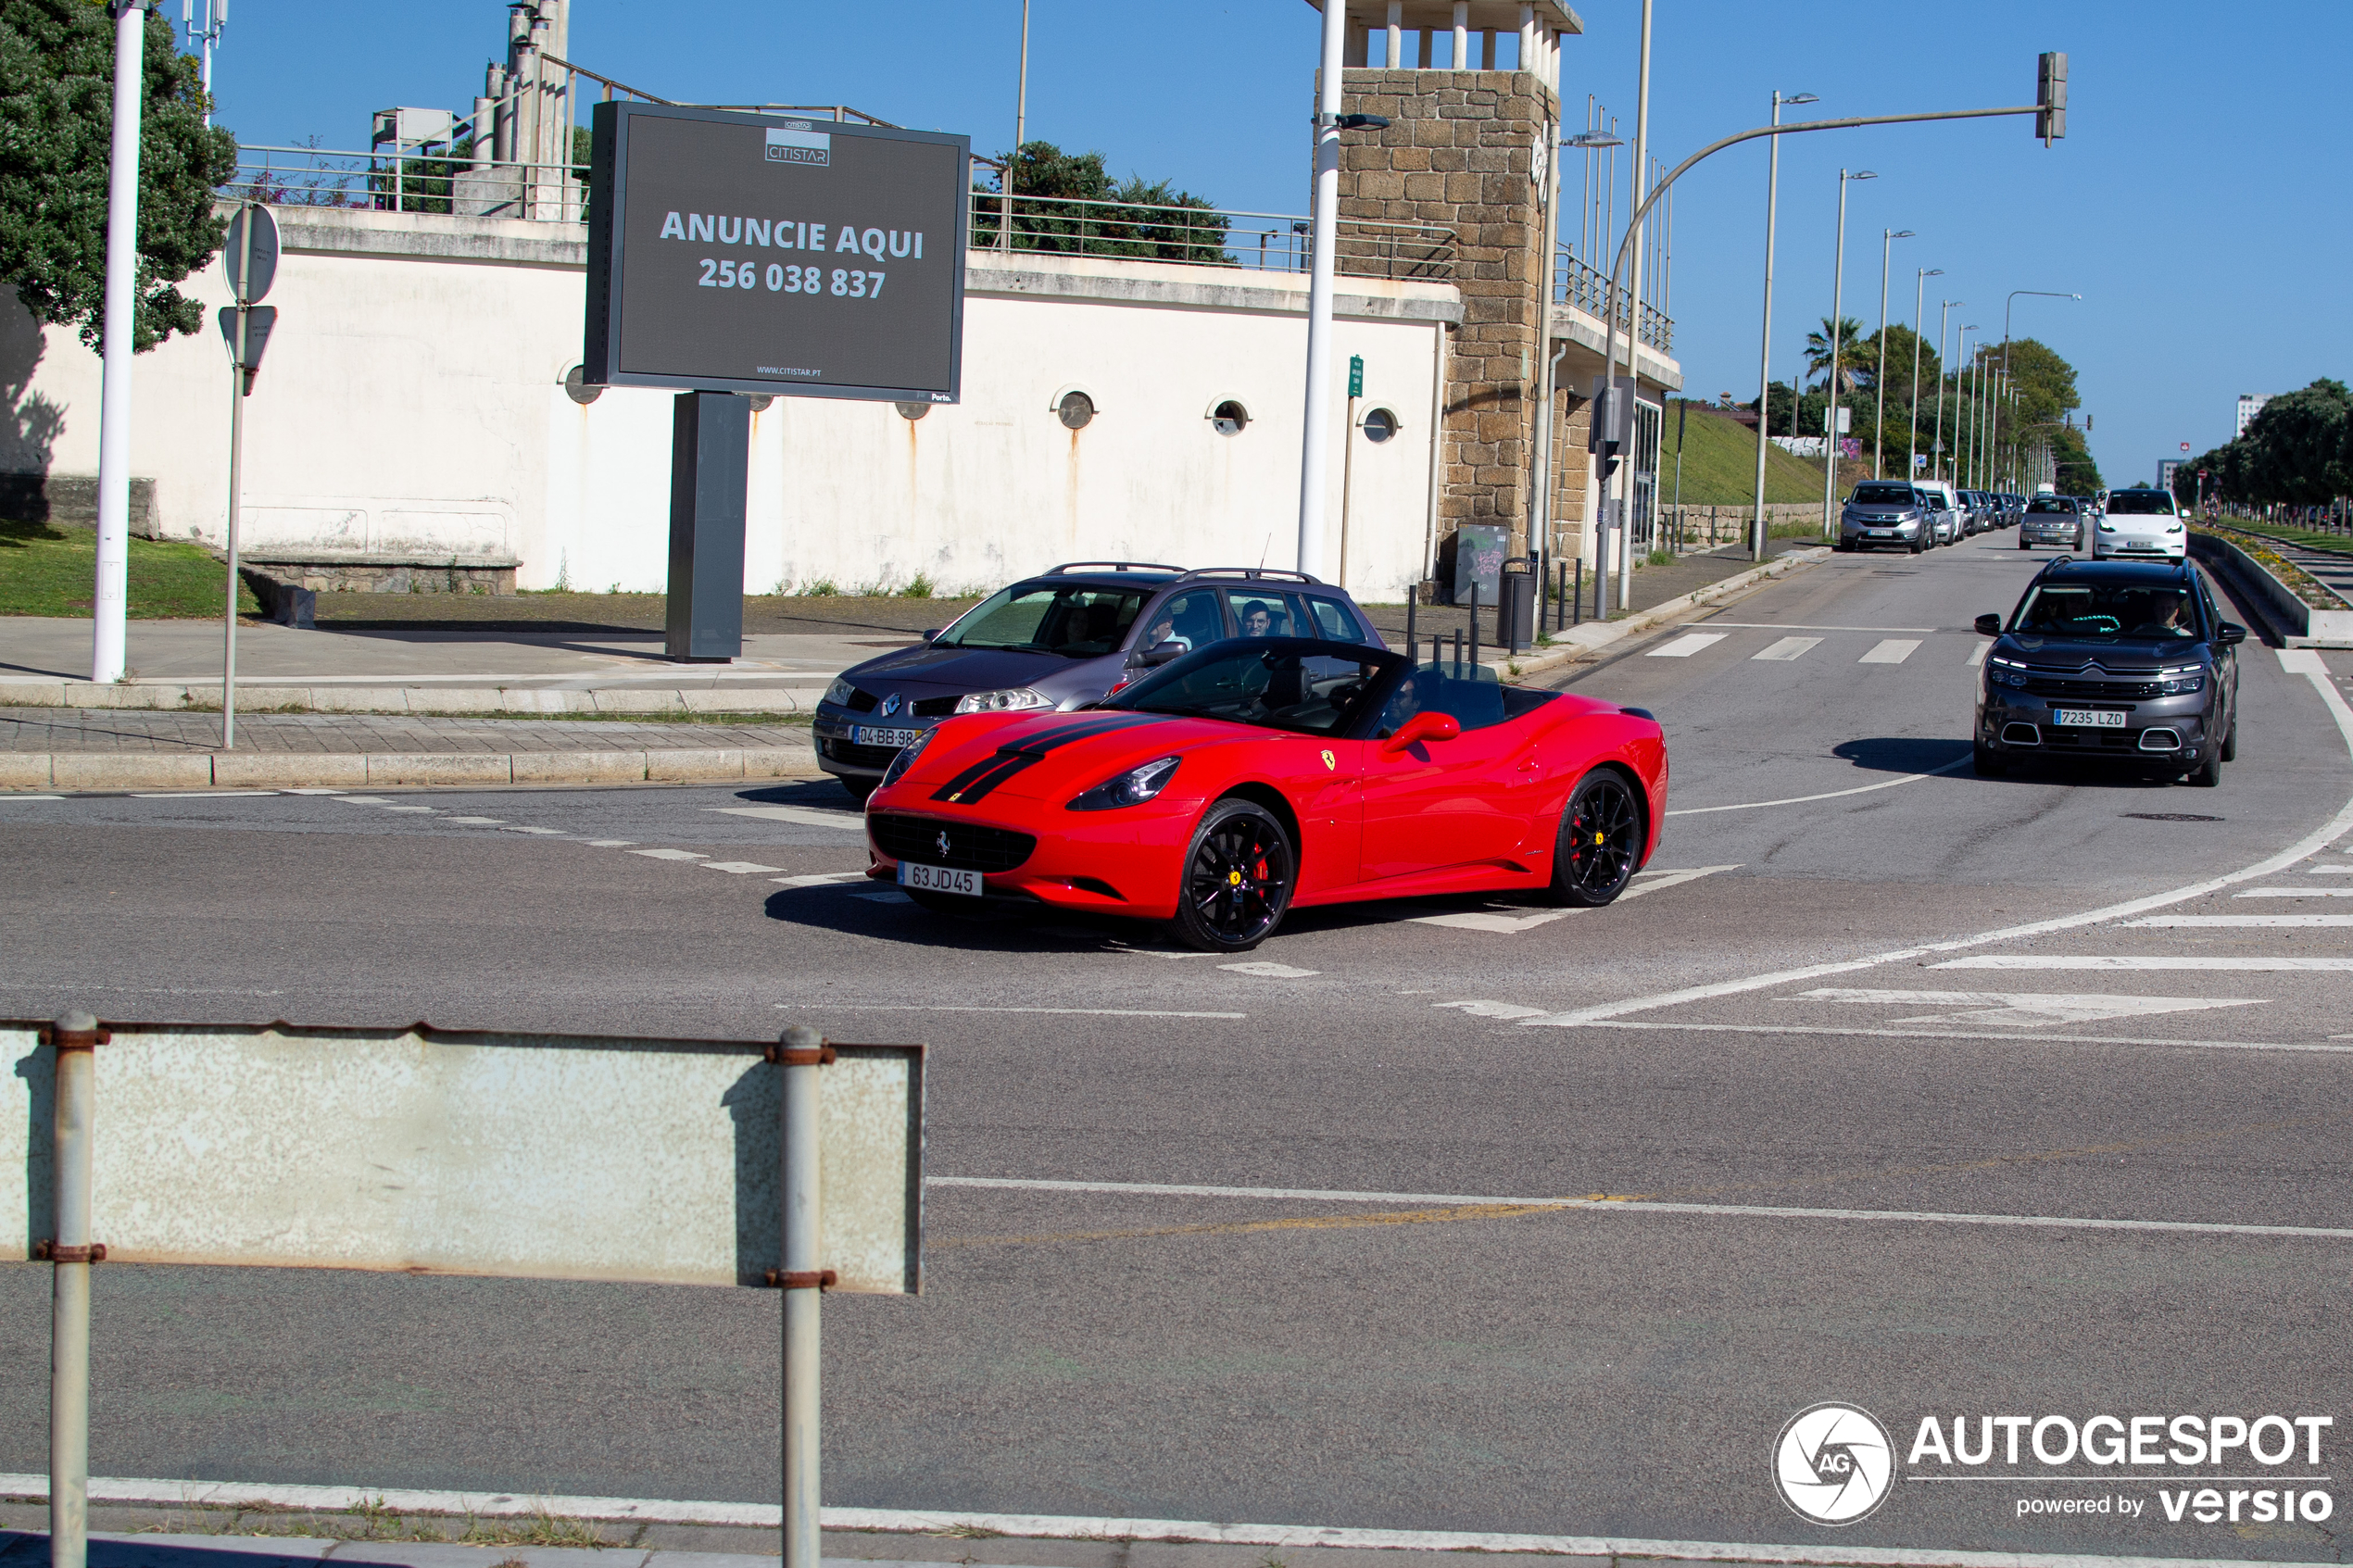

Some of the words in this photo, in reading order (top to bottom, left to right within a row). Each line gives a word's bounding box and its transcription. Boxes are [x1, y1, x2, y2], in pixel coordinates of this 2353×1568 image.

[769, 146, 826, 163] CITISTAR
[660, 211, 825, 252] ANUNCIE
[835, 226, 924, 262] AQUI
[698, 258, 756, 289] 256
[765, 263, 822, 295] 038
[830, 269, 886, 298] 837
[756, 366, 822, 377] WWW.CITISTAR.PT
[931, 393, 952, 402] Porto.
[2062, 711, 2093, 723] 7235
[2097, 712, 2122, 725] LZD
